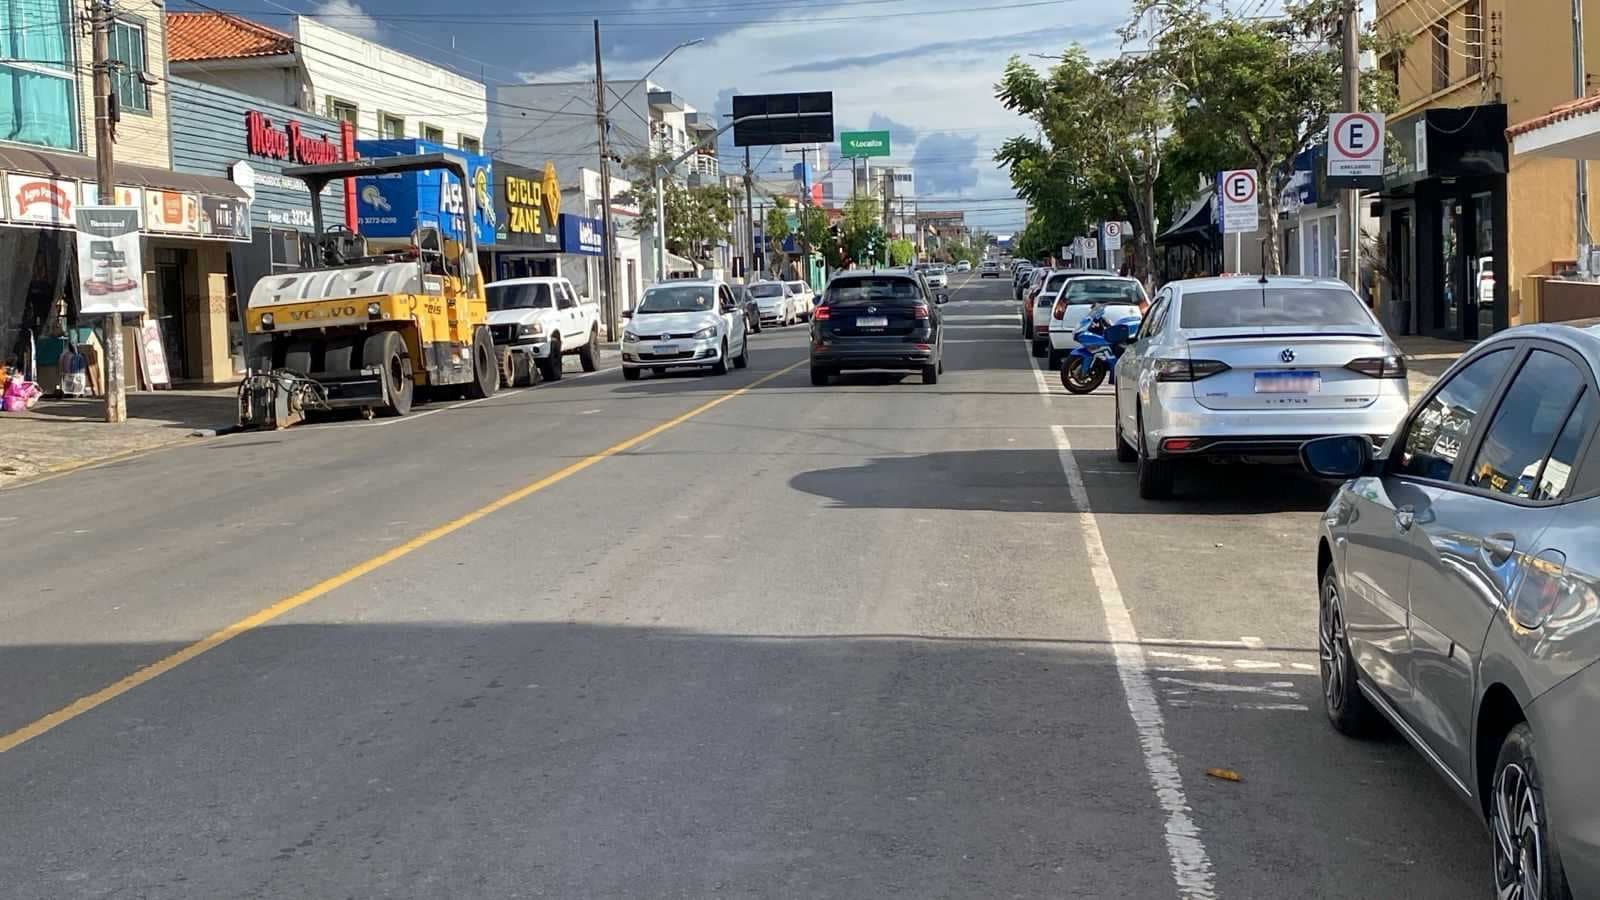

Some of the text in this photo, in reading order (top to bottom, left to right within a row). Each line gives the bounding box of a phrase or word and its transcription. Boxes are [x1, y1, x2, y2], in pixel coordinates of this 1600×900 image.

[1349, 124, 1363, 148] E
[506, 176, 541, 206] CICLO
[1234, 178, 1246, 196] E
[510, 206, 541, 234] ZANE
